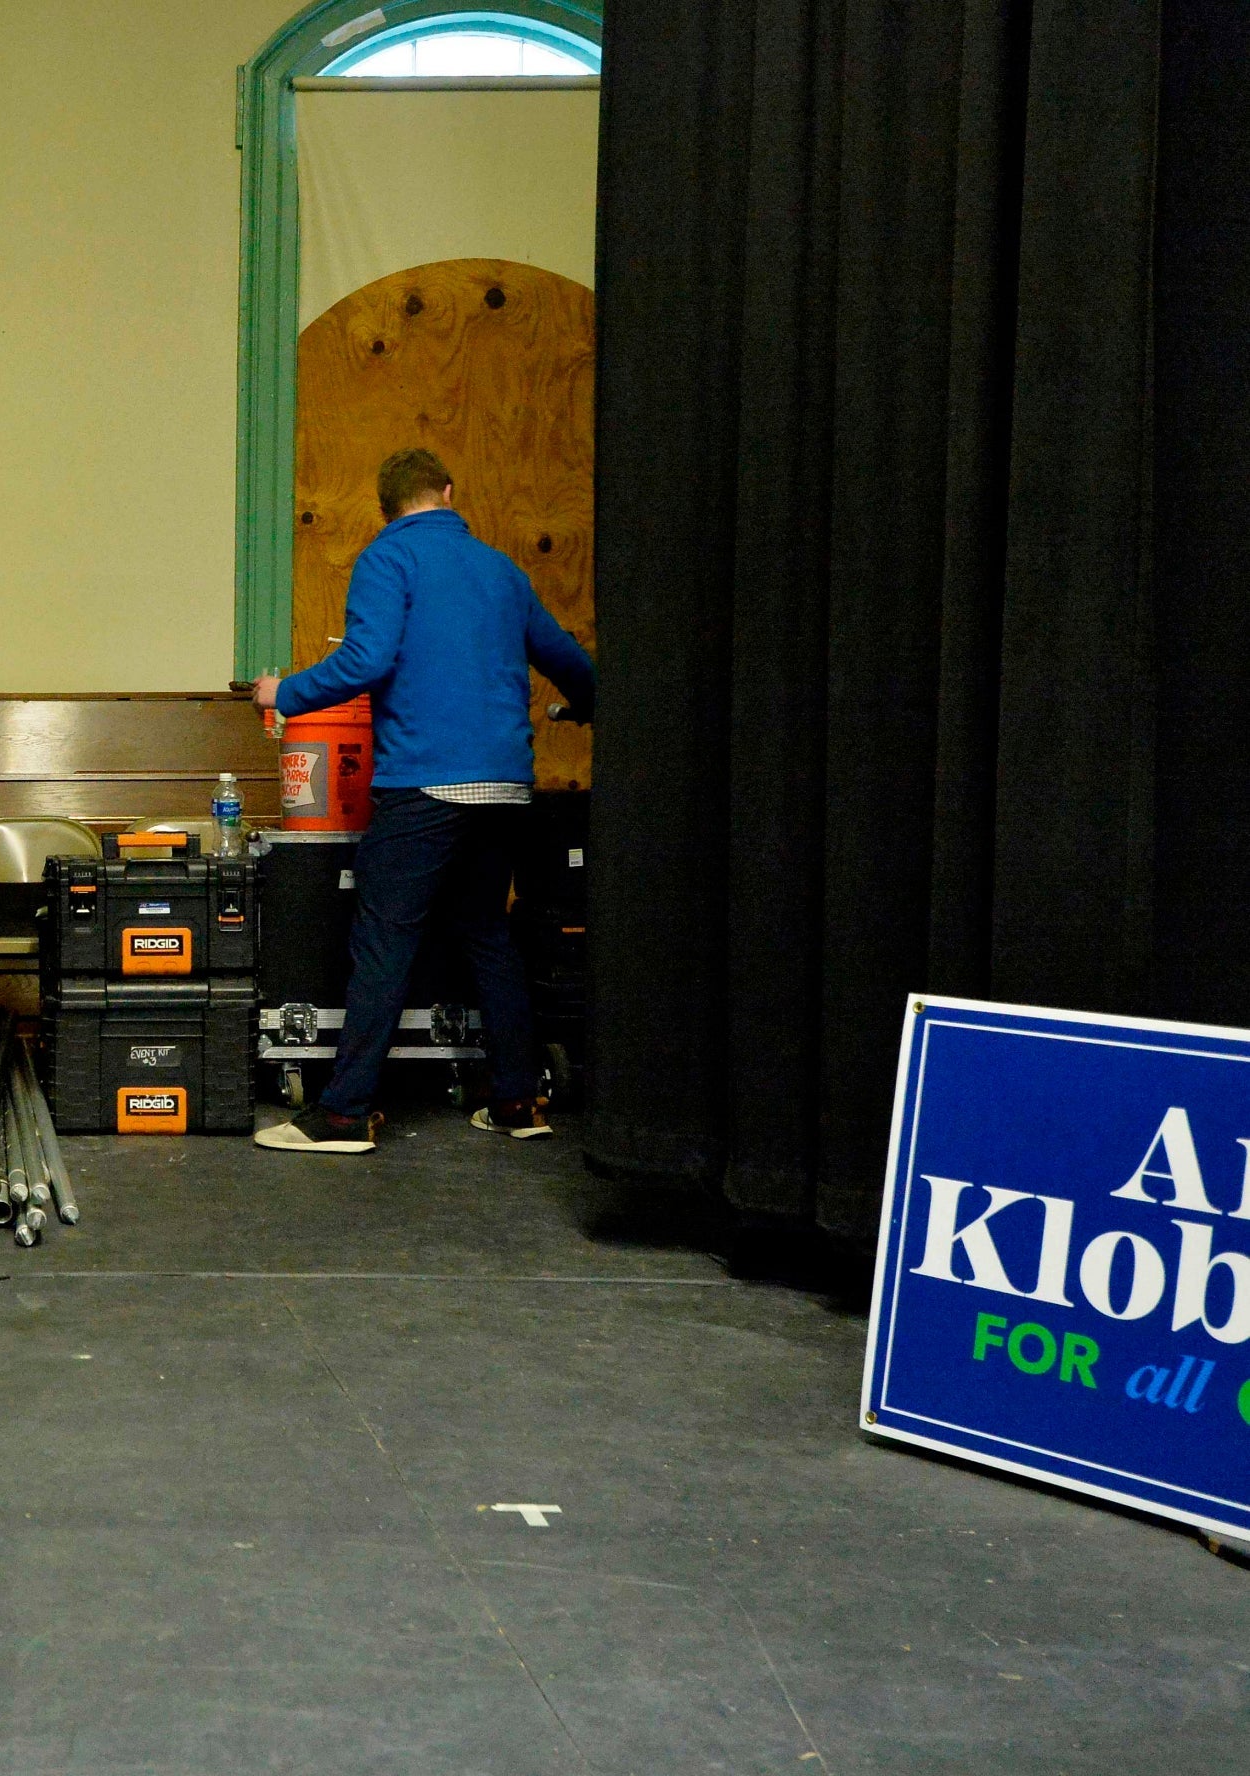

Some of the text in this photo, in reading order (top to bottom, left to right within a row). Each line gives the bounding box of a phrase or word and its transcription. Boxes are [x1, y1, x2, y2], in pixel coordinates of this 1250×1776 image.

[134, 938, 180, 949] RIDGID
[130, 1048, 171, 1059] EVENT KIT
[129, 1098, 175, 1109] RIDGID
[1109, 1106, 1250, 1220] A
[972, 1311, 1100, 1389] FOR
[1124, 1354, 1217, 1413] all
